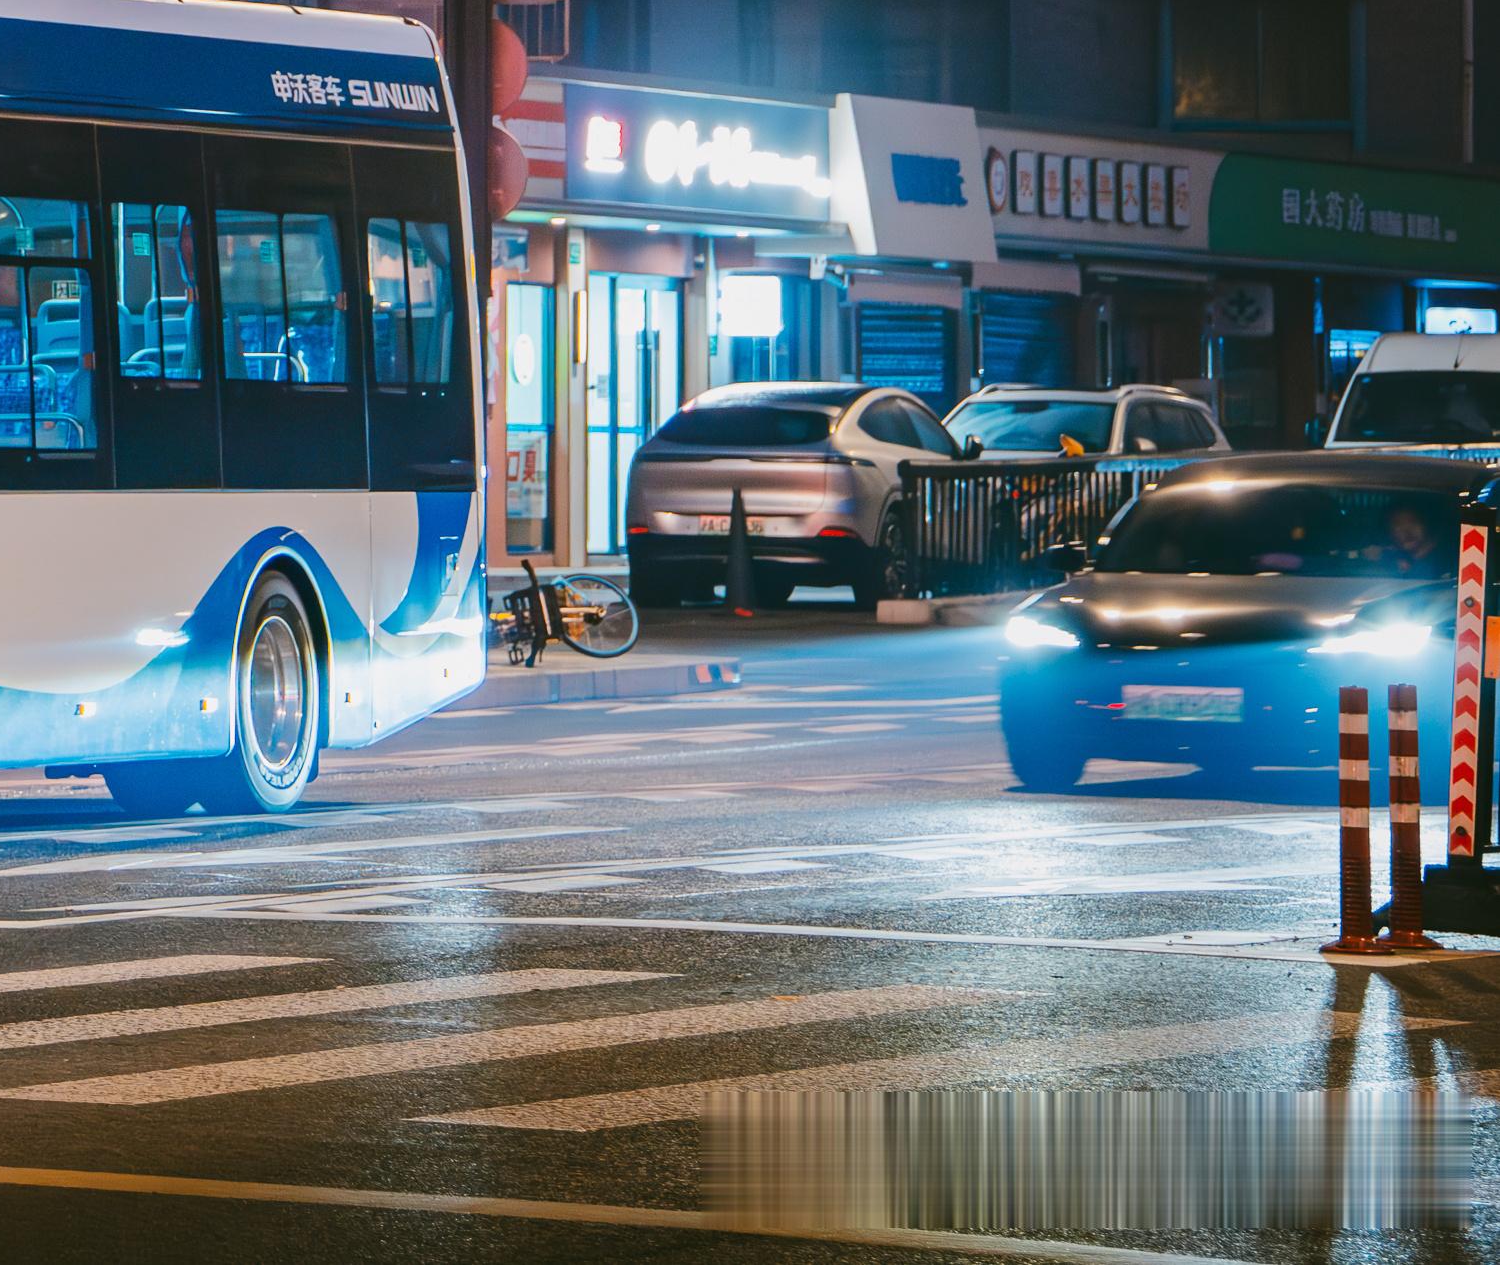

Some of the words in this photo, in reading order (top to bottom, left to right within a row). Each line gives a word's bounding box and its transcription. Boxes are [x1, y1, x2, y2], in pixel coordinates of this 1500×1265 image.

[271, 70, 345, 107] 申沃客车
[348, 79, 440, 113] SUNWIN
[1282, 188, 1365, 233] 国大药房
